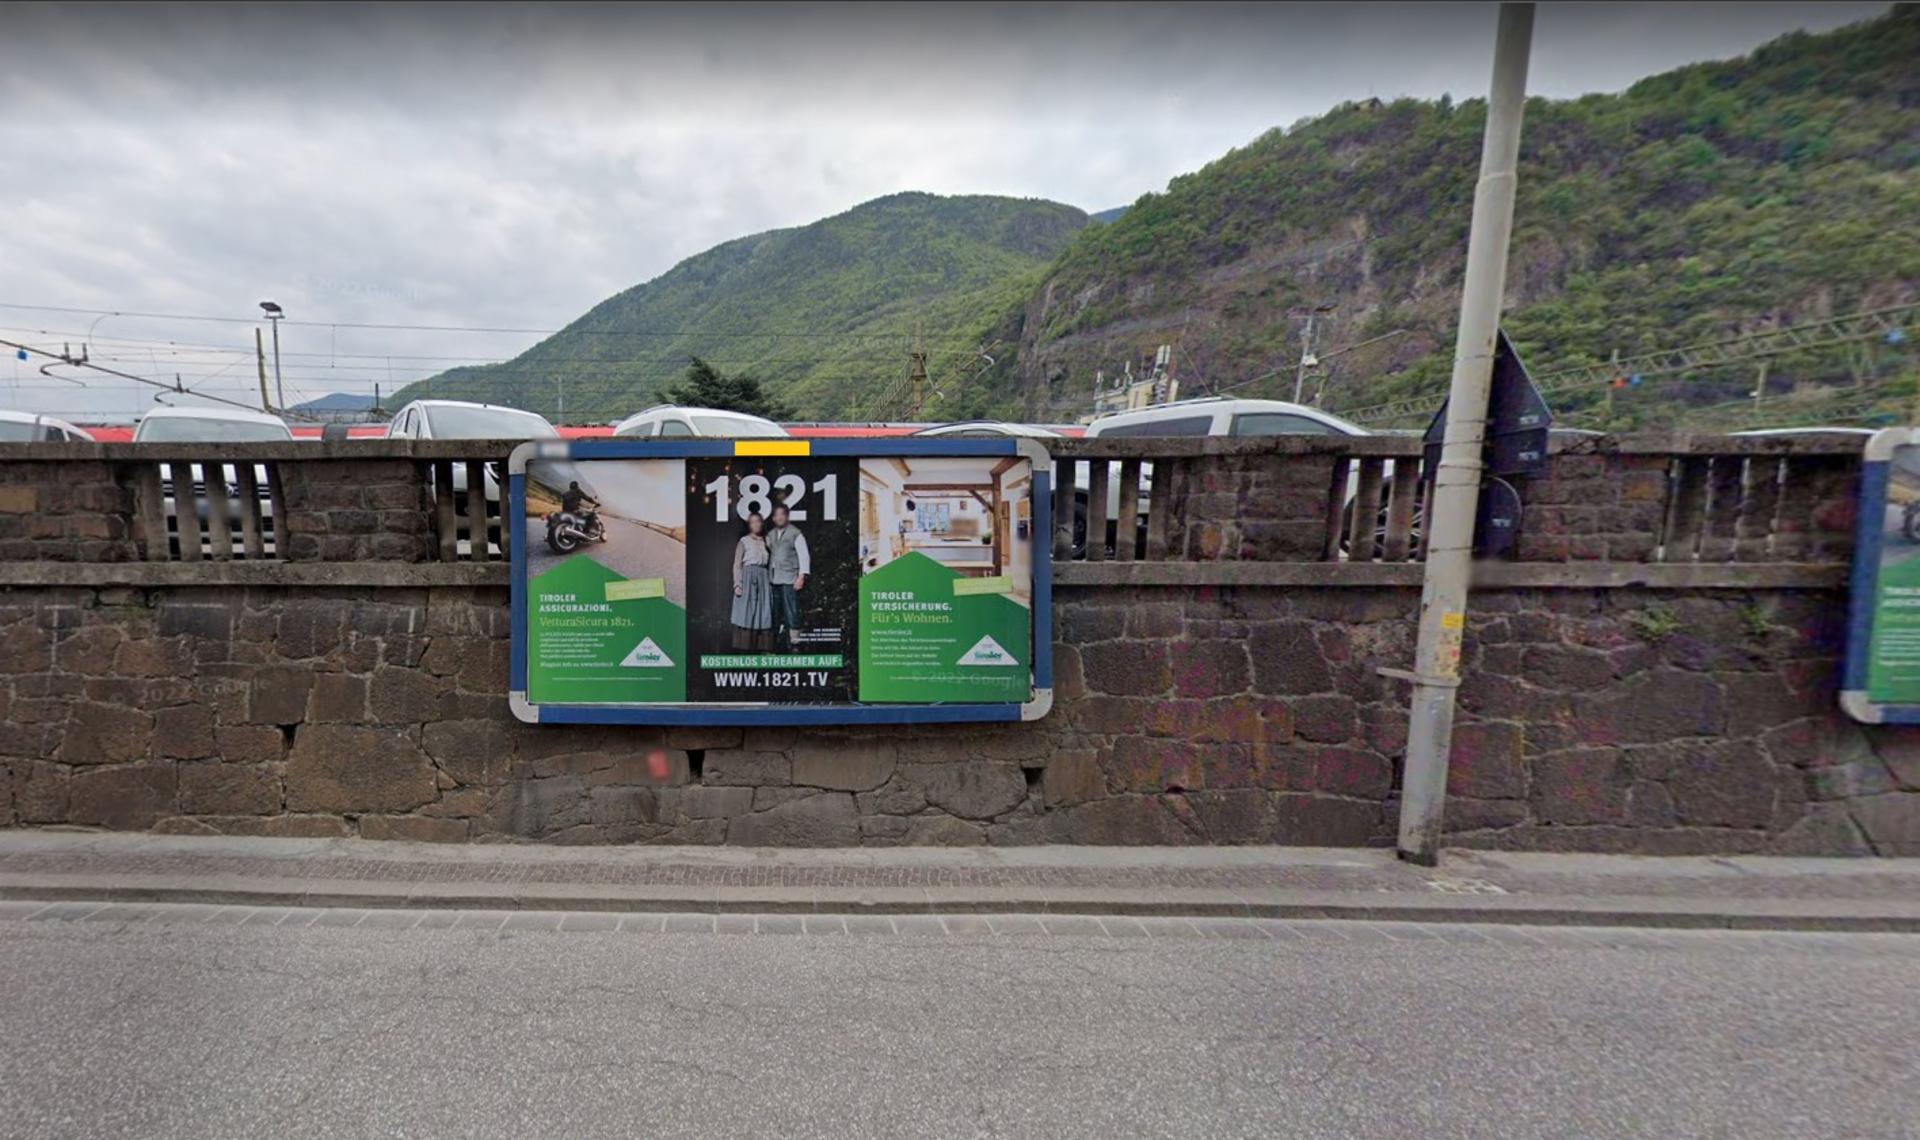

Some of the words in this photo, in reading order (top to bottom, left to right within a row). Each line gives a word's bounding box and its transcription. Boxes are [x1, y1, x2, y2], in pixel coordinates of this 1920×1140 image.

[705, 474, 838, 522] 1821
[539, 594, 576, 602] TIROLER
[871, 591, 914, 600] TIROLER
[539, 603, 613, 612] ASSICURAZIONI.
[871, 602, 953, 611] VERSICHERUNG.
[902, 613, 953, 623] Wohnen.
[701, 655, 758, 667] KOSTENLOS
[760, 655, 815, 667] STREAMEN
[714, 671, 829, 687] WWW.1821.TV
